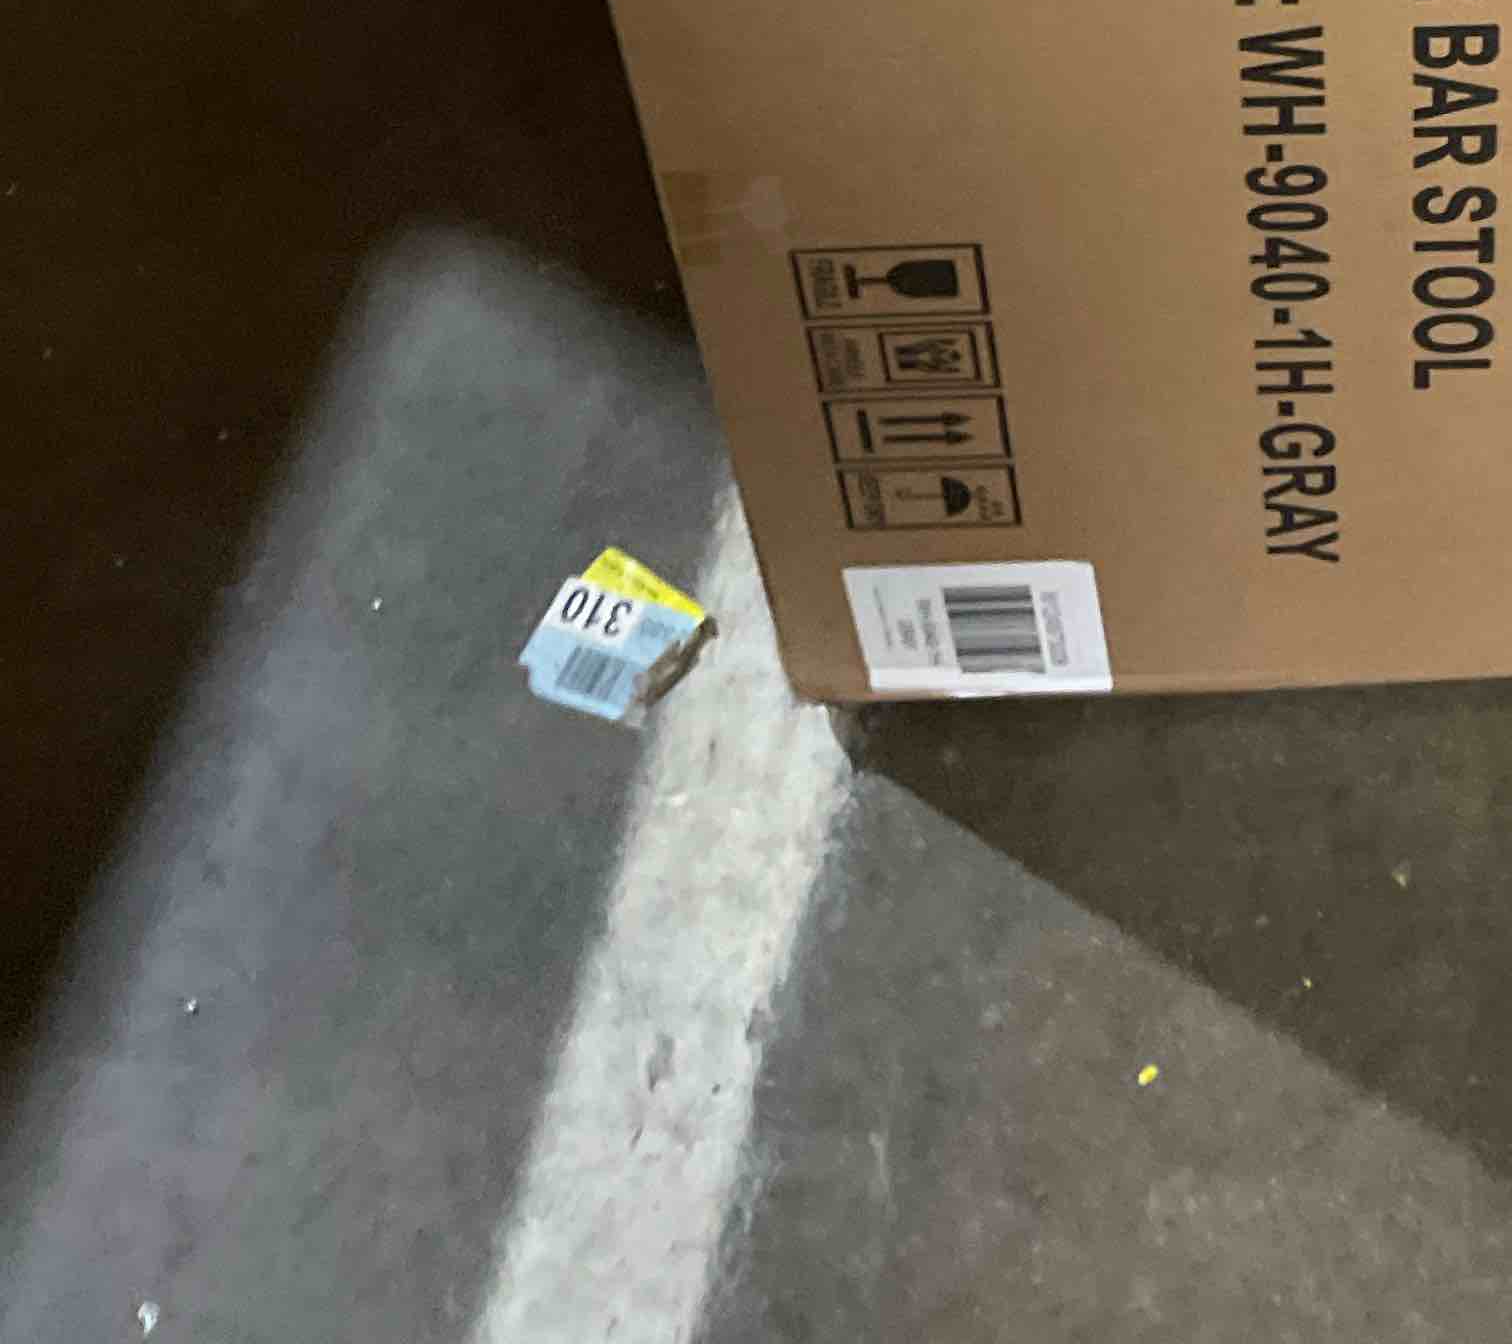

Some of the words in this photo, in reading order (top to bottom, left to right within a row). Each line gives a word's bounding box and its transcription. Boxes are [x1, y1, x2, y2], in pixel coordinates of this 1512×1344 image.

[1411, 22, 1501, 170] BAR
[1236, 25, 1341, 565] WH-9040-1H-GRAY
[1410, 184, 1500, 391] STOOL
[560, 587, 633, 636] 310
